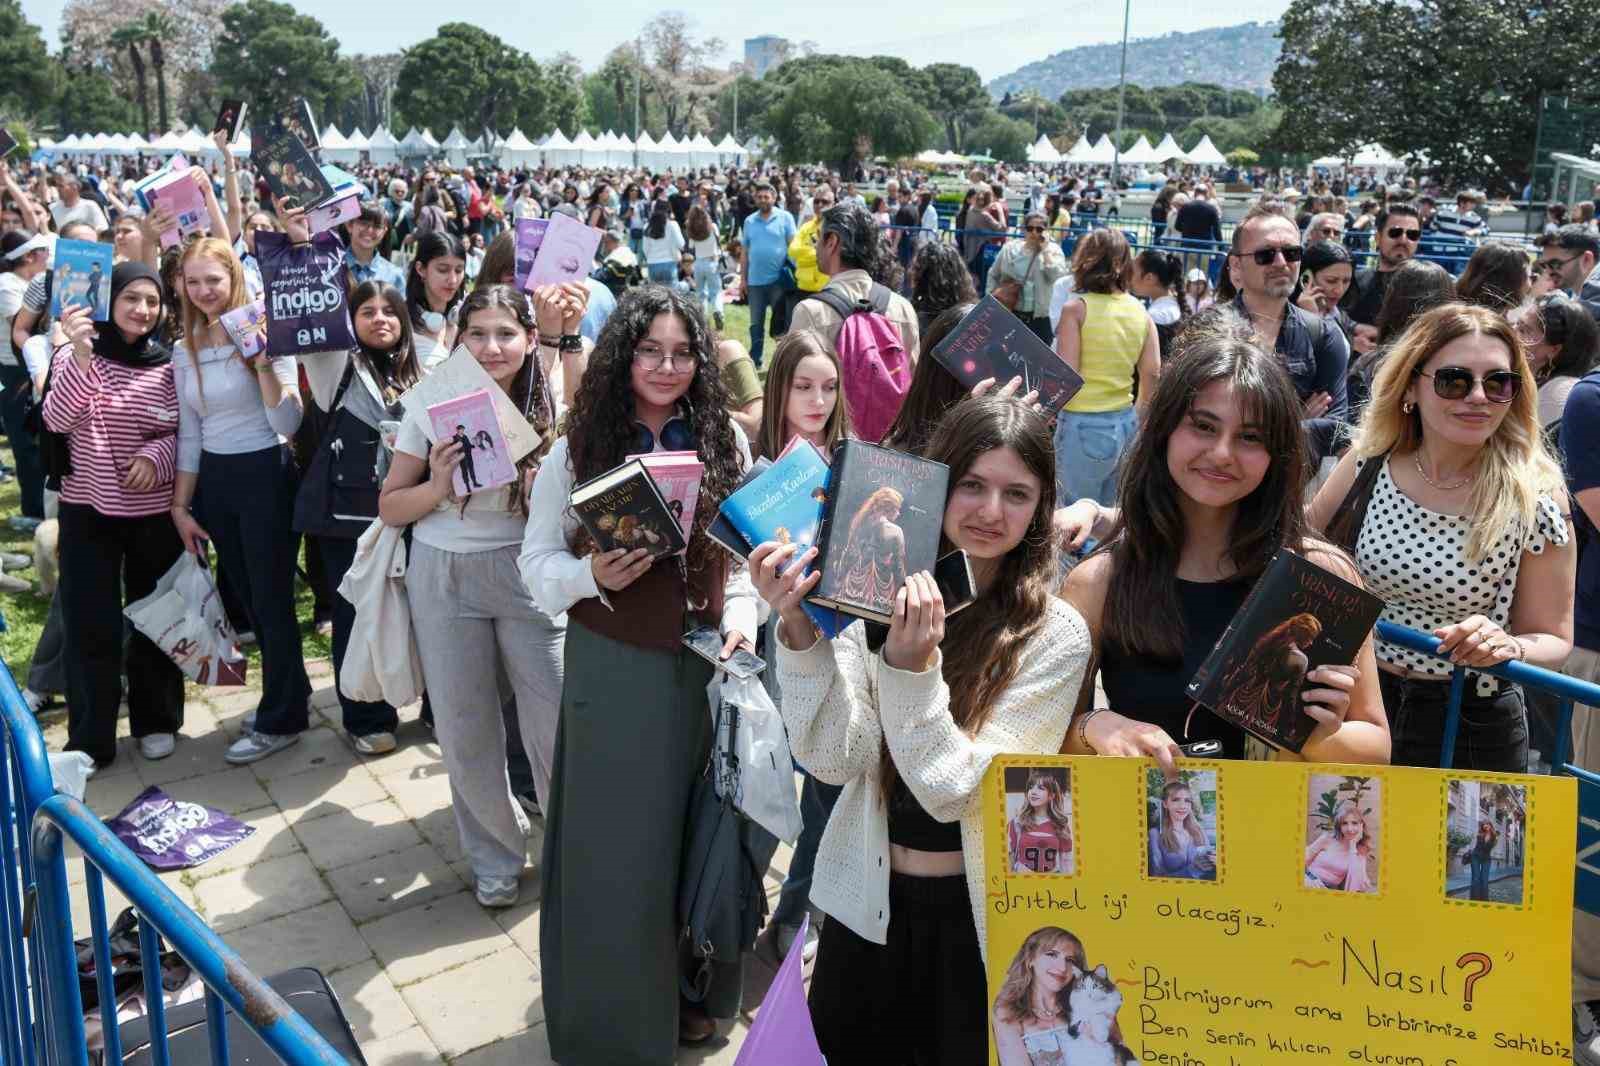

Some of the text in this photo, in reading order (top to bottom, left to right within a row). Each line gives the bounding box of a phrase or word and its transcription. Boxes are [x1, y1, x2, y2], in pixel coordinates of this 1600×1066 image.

[272, 287, 340, 312] indigo
[1104, 894, 1128, 920] iyi
[1139, 1004, 1189, 1039] Ben
[1295, 1005, 1343, 1021] ama
[1366, 1005, 1478, 1041] birbirimize
